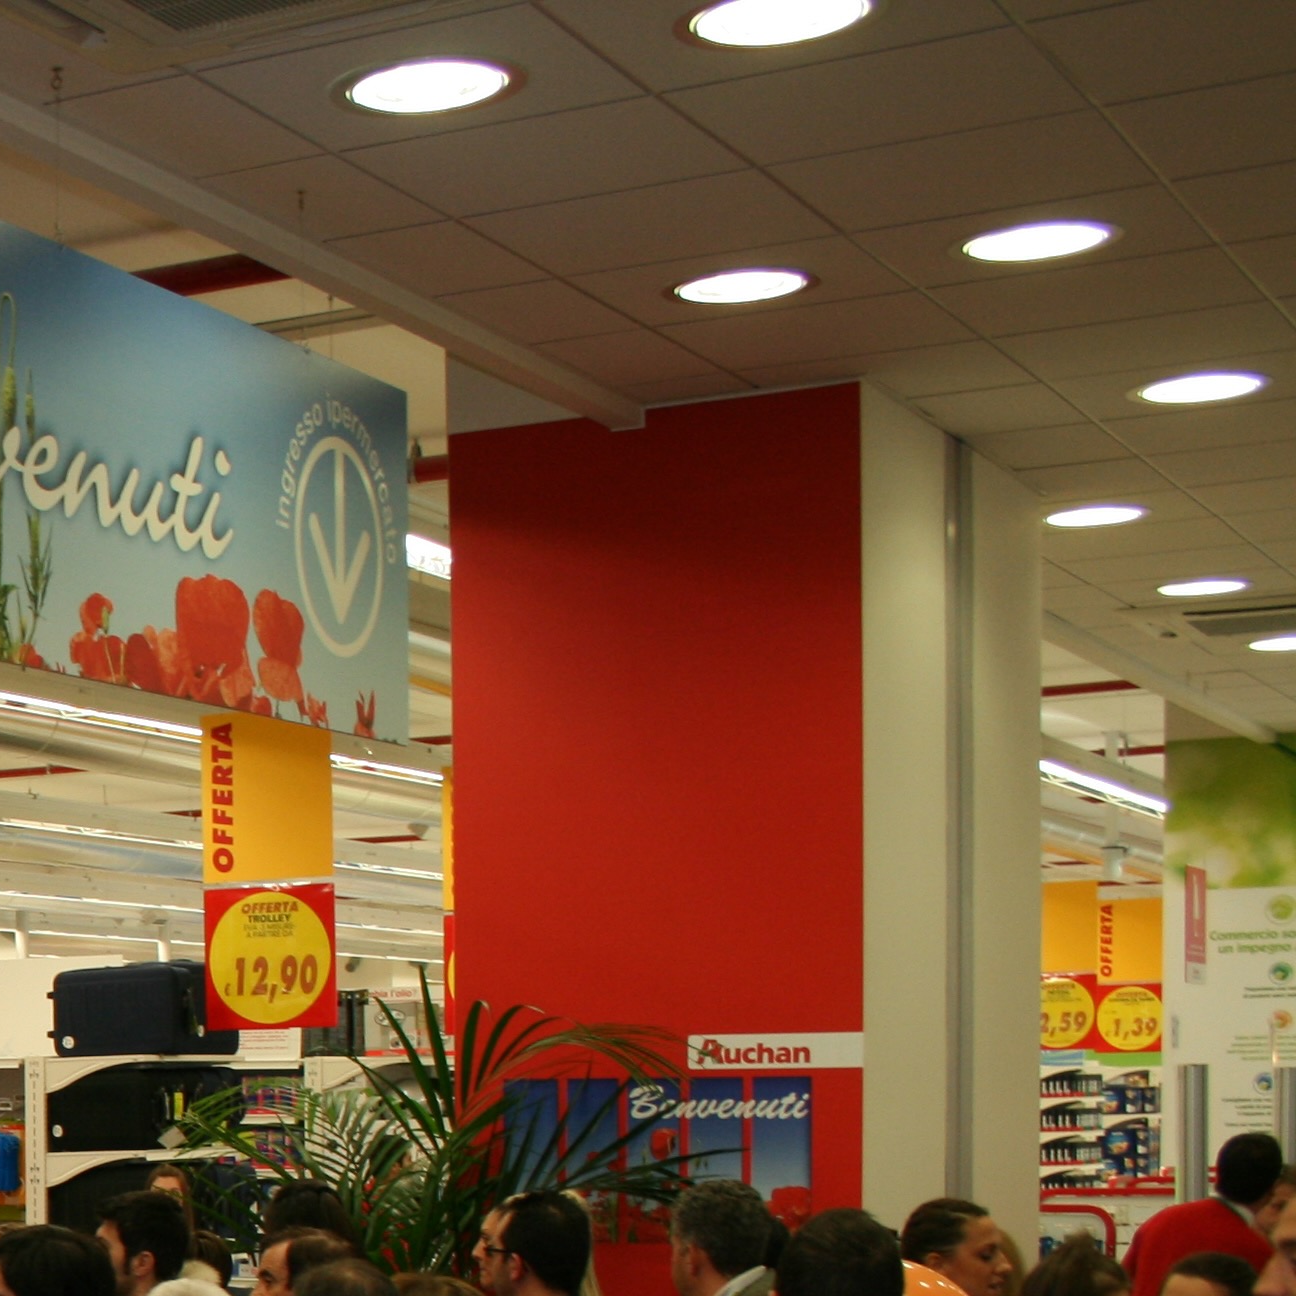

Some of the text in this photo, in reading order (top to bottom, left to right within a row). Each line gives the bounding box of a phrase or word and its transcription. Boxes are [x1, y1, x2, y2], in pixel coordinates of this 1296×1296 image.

[275, 402, 324, 530] ingresso
[325, 392, 398, 565] ipermercato
[211, 722, 234, 873] OFFERTA
[241, 901, 298, 914] OFFERTA
[247, 914, 291, 923] TROLLEY
[1100, 903, 1114, 978] OFFERTA
[698, 1038, 811, 1065] Auchan
